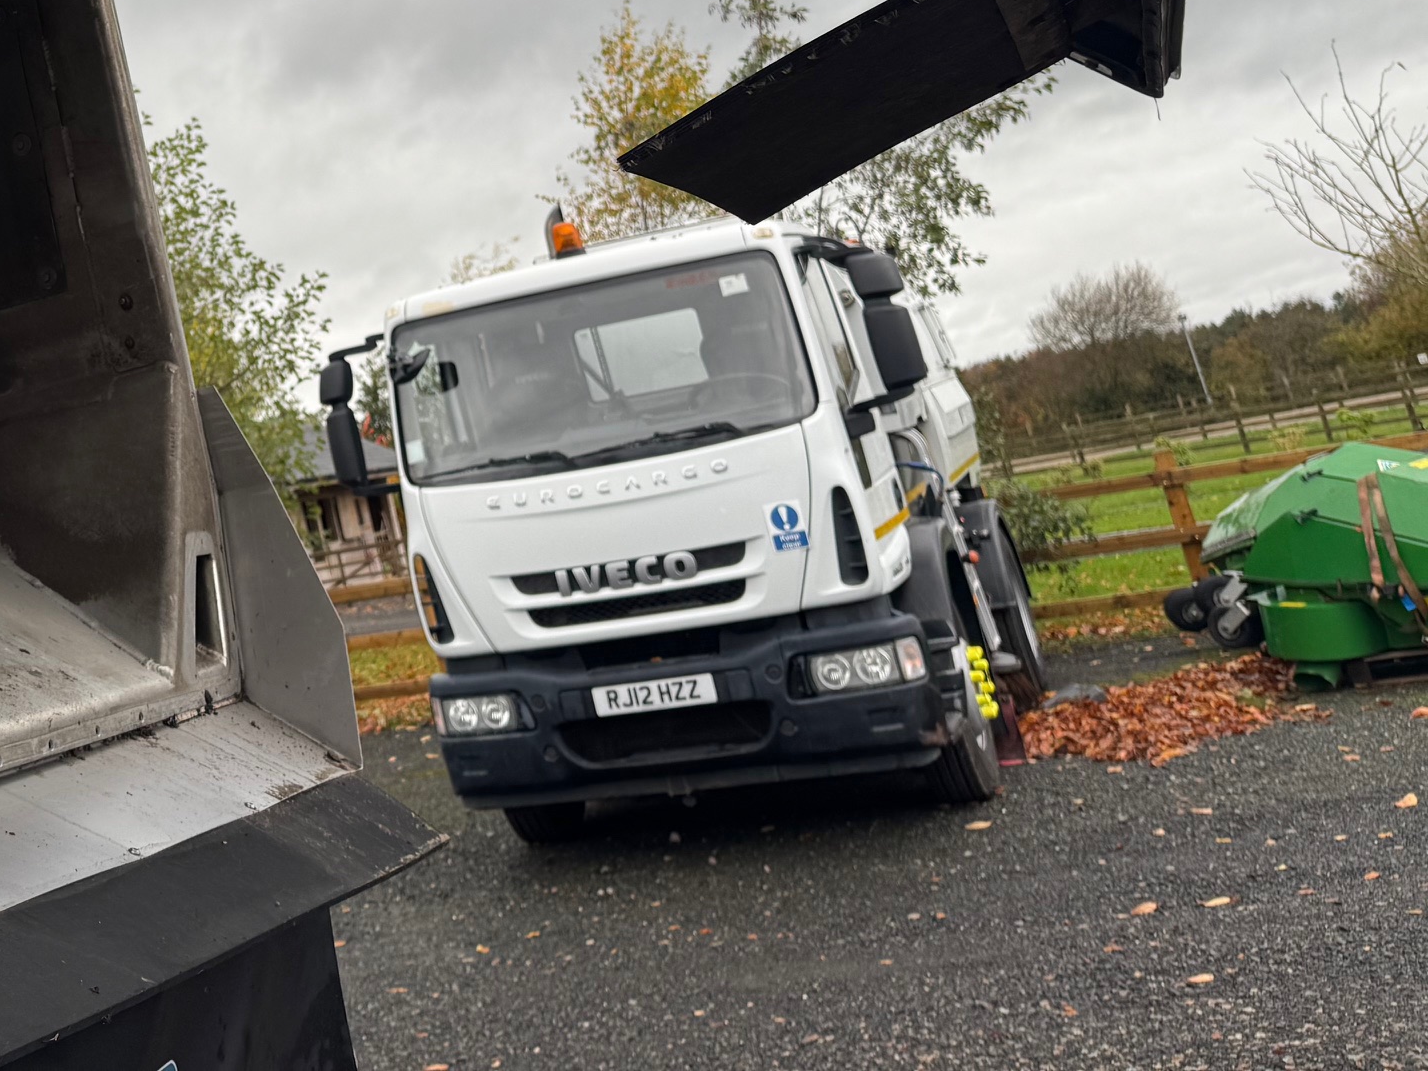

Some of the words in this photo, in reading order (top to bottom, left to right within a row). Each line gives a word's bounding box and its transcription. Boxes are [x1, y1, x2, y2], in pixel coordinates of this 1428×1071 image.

[486, 458, 728, 510] EUROCARGO
[554, 550, 699, 597] IVECO
[606, 685, 654, 709] RJ12
[657, 679, 701, 704] HZZ
